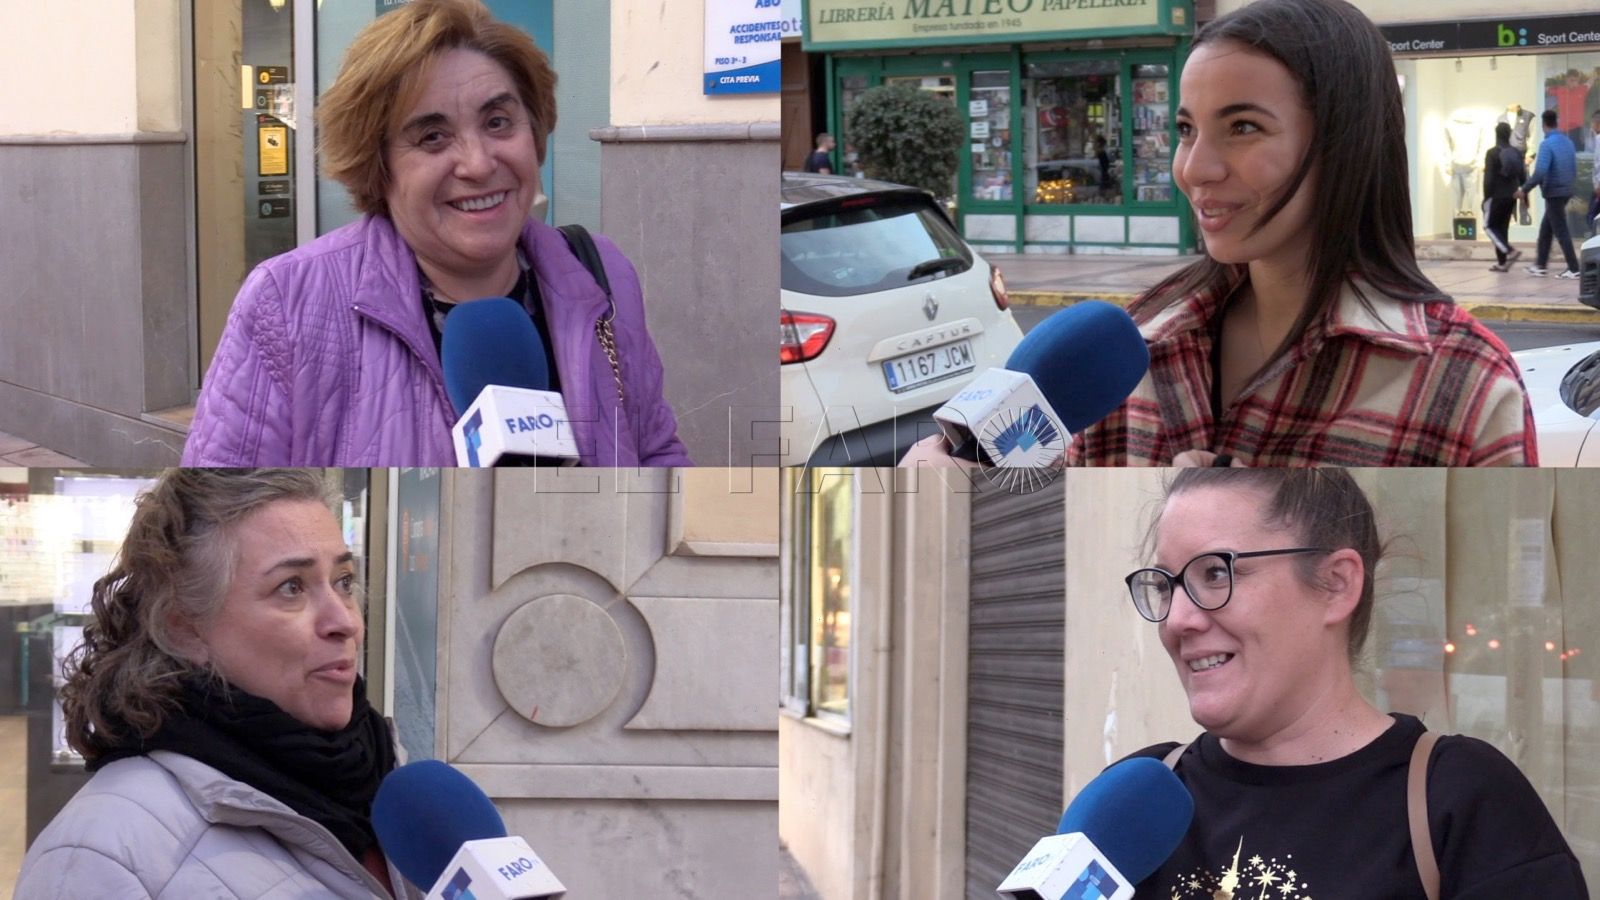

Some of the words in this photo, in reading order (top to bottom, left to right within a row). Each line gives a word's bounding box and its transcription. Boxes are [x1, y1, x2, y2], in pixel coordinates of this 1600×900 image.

[819, 2, 894, 24] LIBRERÍA
[903, 0, 1032, 19] MATEO
[730, 21, 780, 34] ACCIDENTES
[987, 20, 999, 28] en
[1001, 18, 1022, 27] 1945
[1412, 39, 1445, 50] Center
[1538, 33, 1566, 46] Sport
[715, 57, 730, 65] PISO
[720, 76, 735, 84] CITA
[736, 75, 760, 83] PREVIA
[897, 325, 970, 351] CAPTUR
[898, 352, 936, 382] 1167
[944, 344, 972, 369] JCM
[505, 413, 553, 434] FARO
[498, 857, 533, 881] FARO
